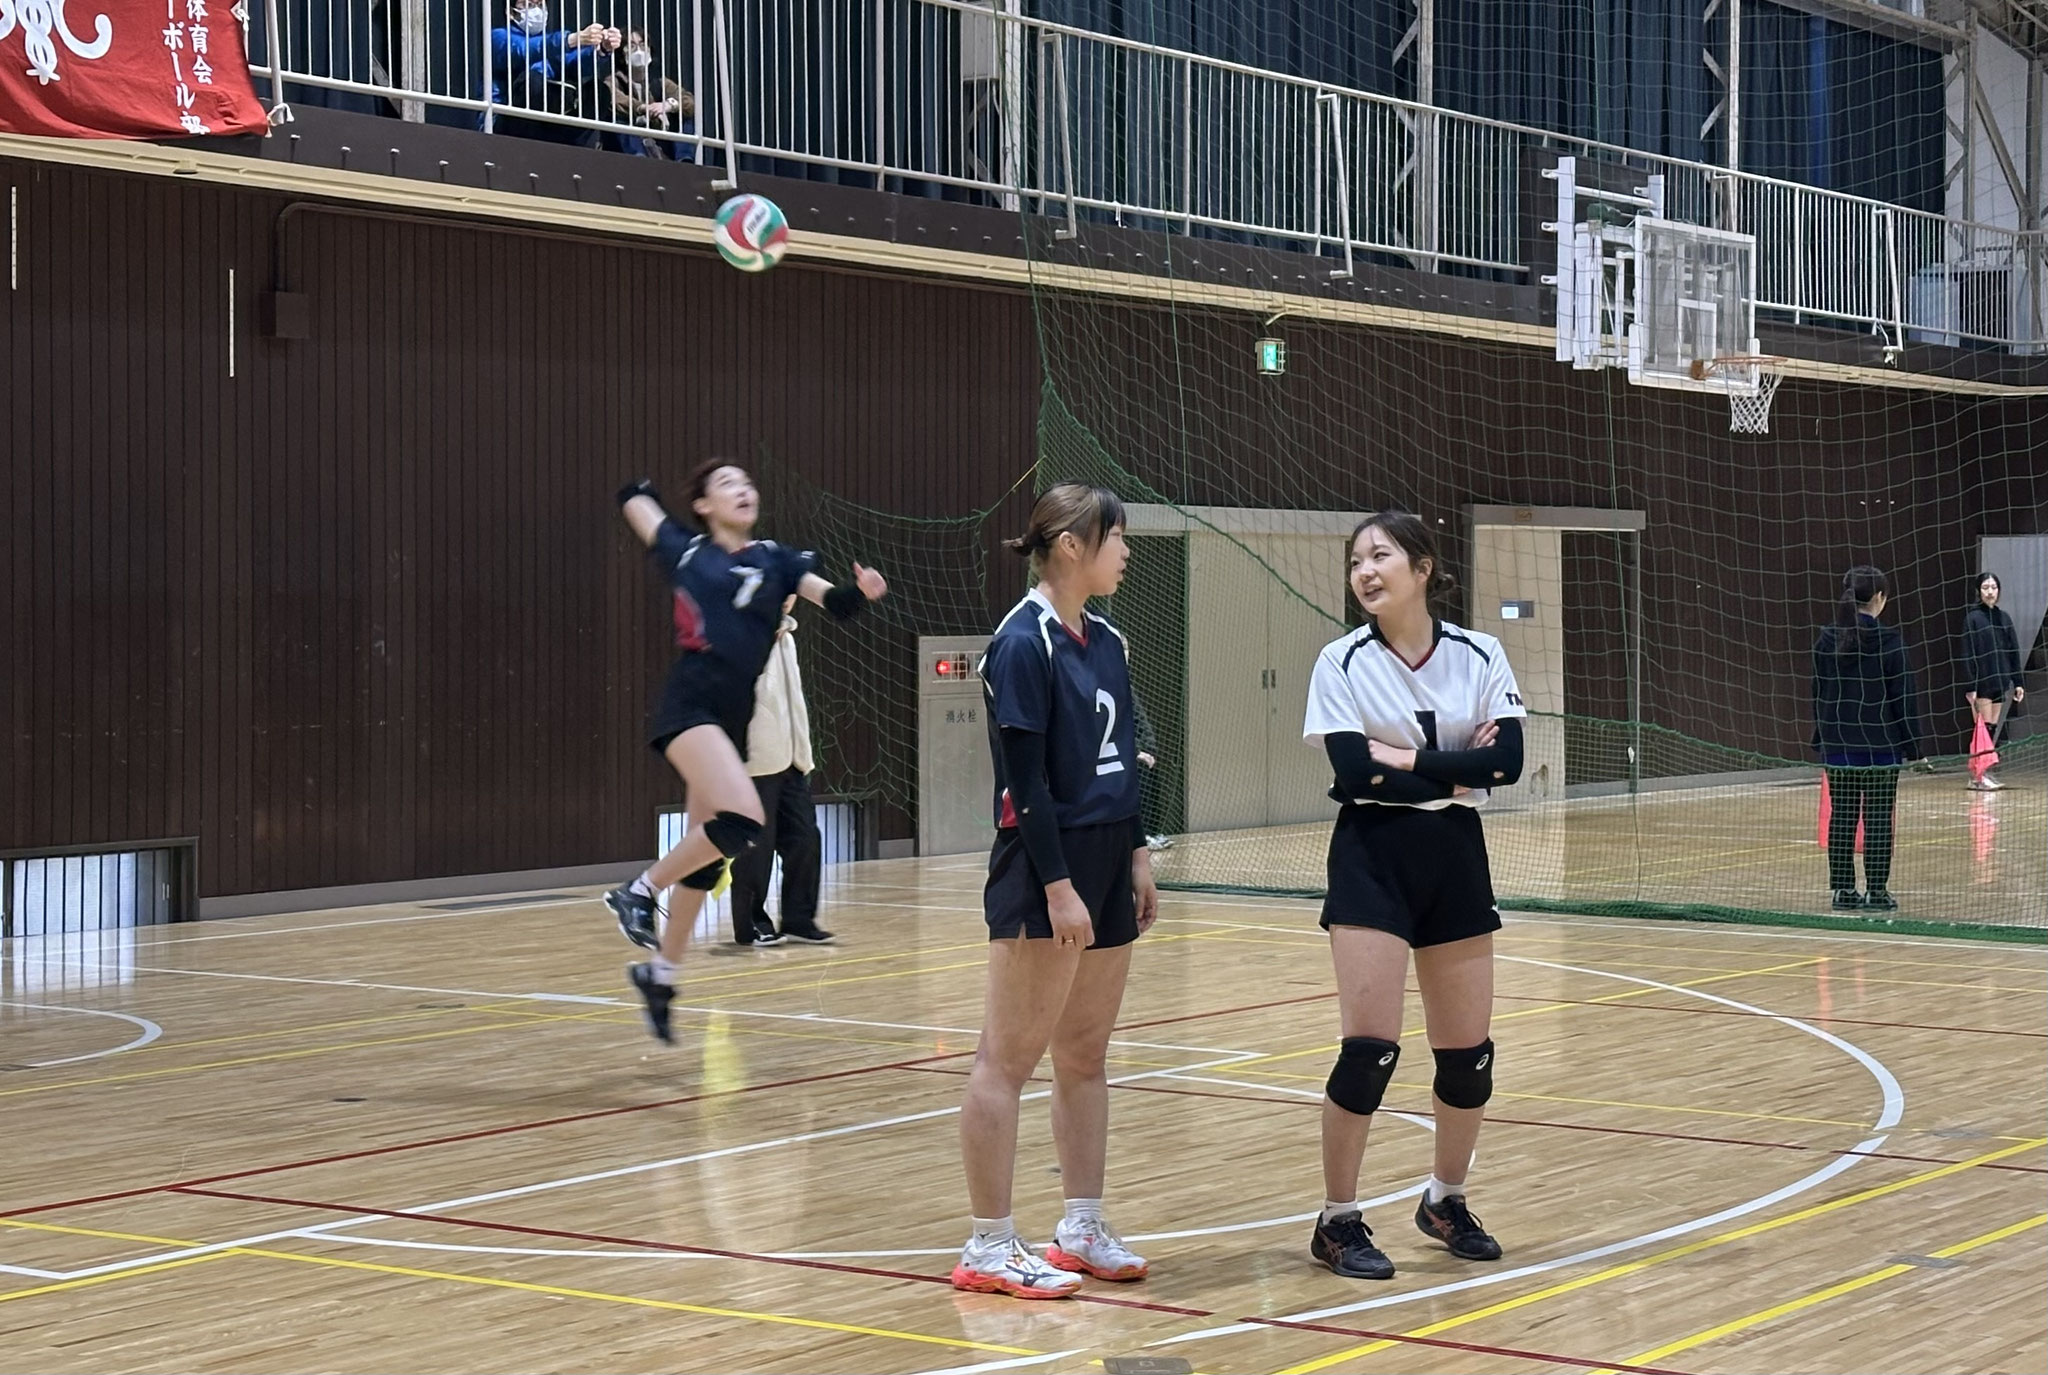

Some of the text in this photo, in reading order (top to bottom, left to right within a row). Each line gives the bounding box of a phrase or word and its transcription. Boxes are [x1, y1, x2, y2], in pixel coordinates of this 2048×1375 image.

[186, 0, 213, 85] 体育会
[729, 565, 763, 609] 7
[1095, 688, 1119, 759] 2
